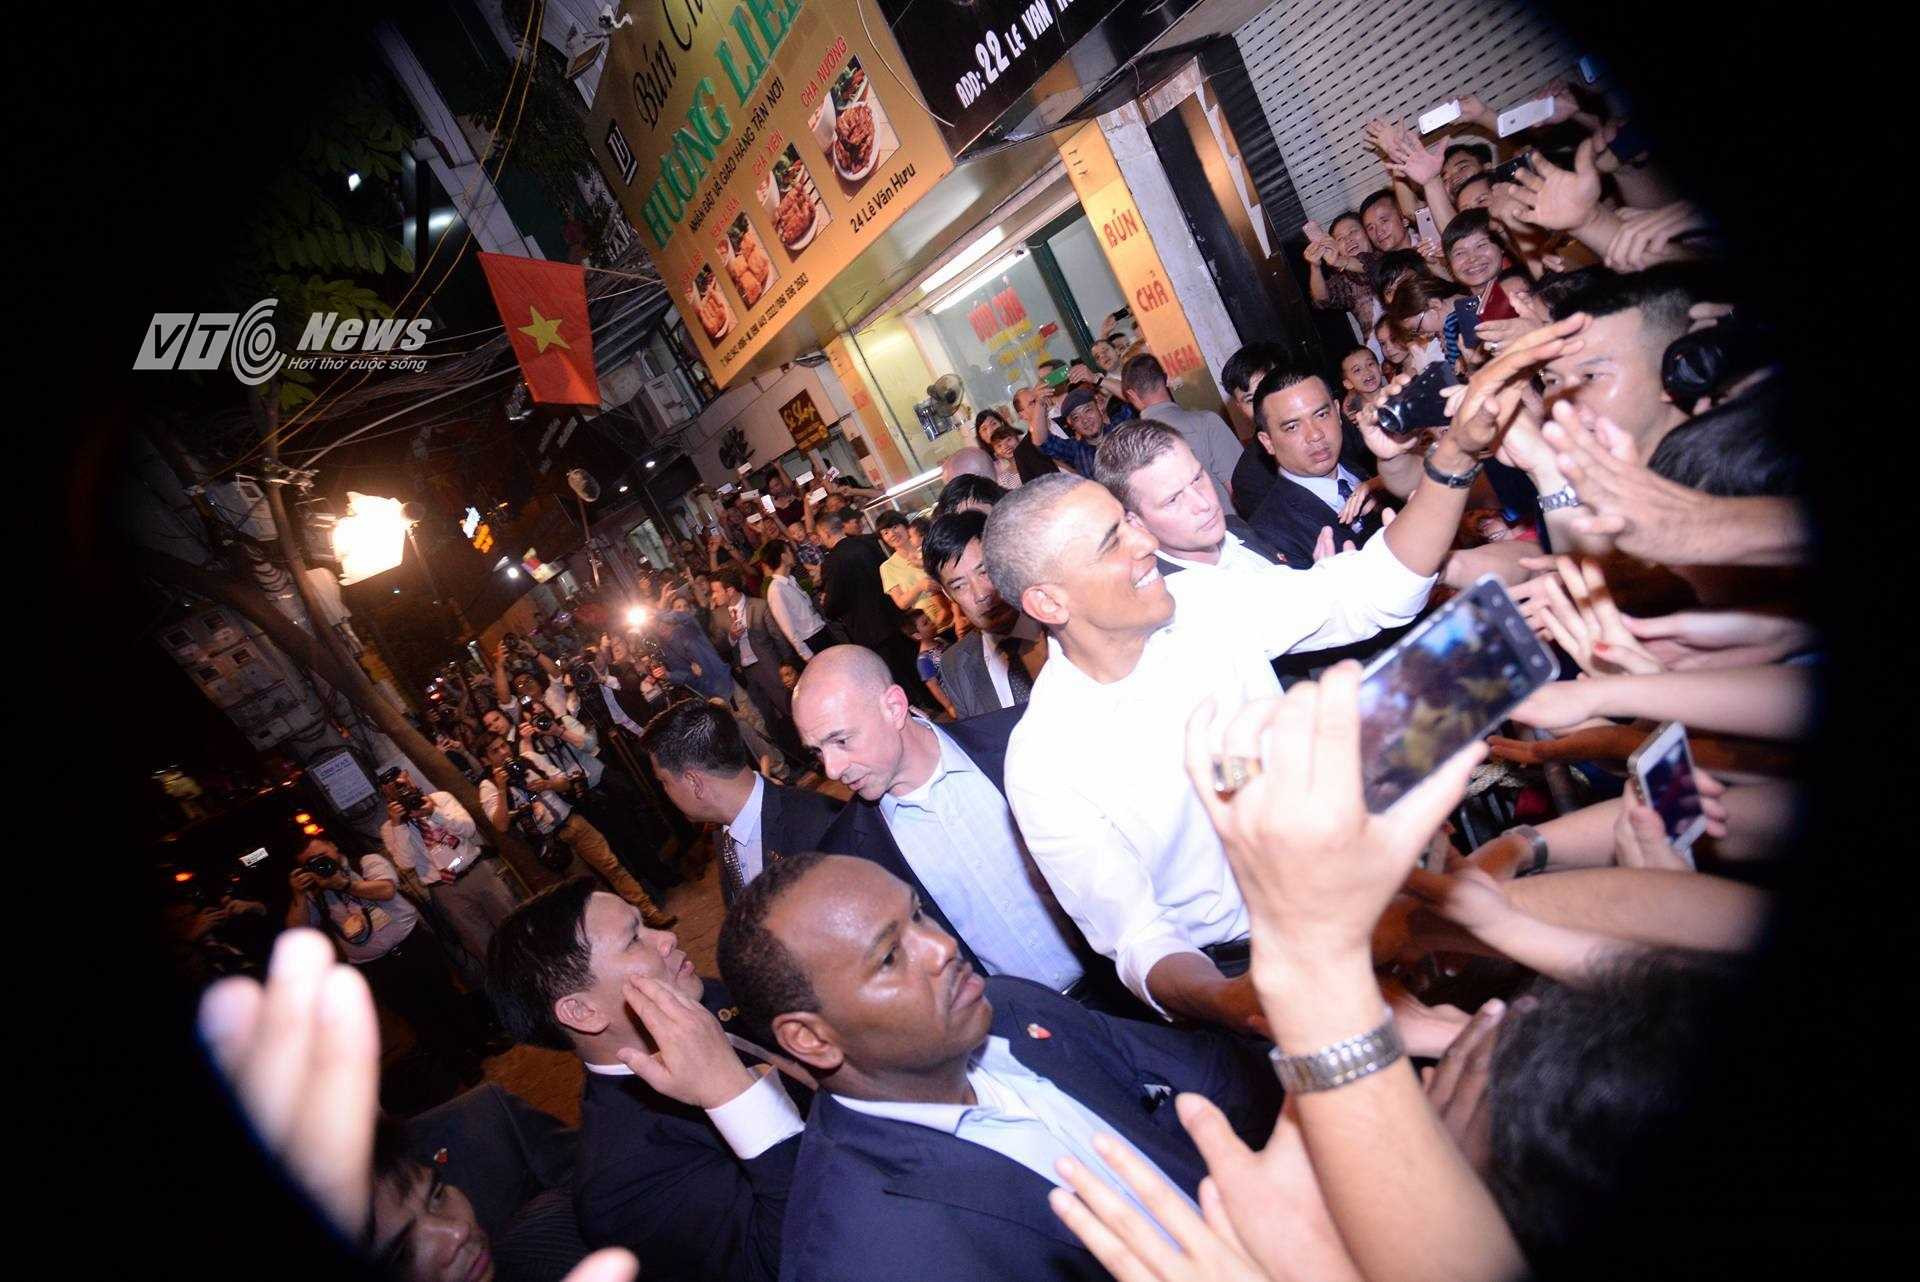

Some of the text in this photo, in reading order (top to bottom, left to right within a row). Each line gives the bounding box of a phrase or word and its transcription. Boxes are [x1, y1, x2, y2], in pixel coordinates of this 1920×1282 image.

[633, 40, 676, 128] Bún
[955, 71, 987, 109] ADD:
[975, 30, 1010, 84] 22
[1004, 23, 1028, 58] LE
[720, 156, 737, 185] GIAO
[850, 213, 864, 234] 24
[861, 201, 876, 222] Lê
[1103, 208, 1139, 249] BÚN
[1136, 269, 1169, 312] CHẢ
